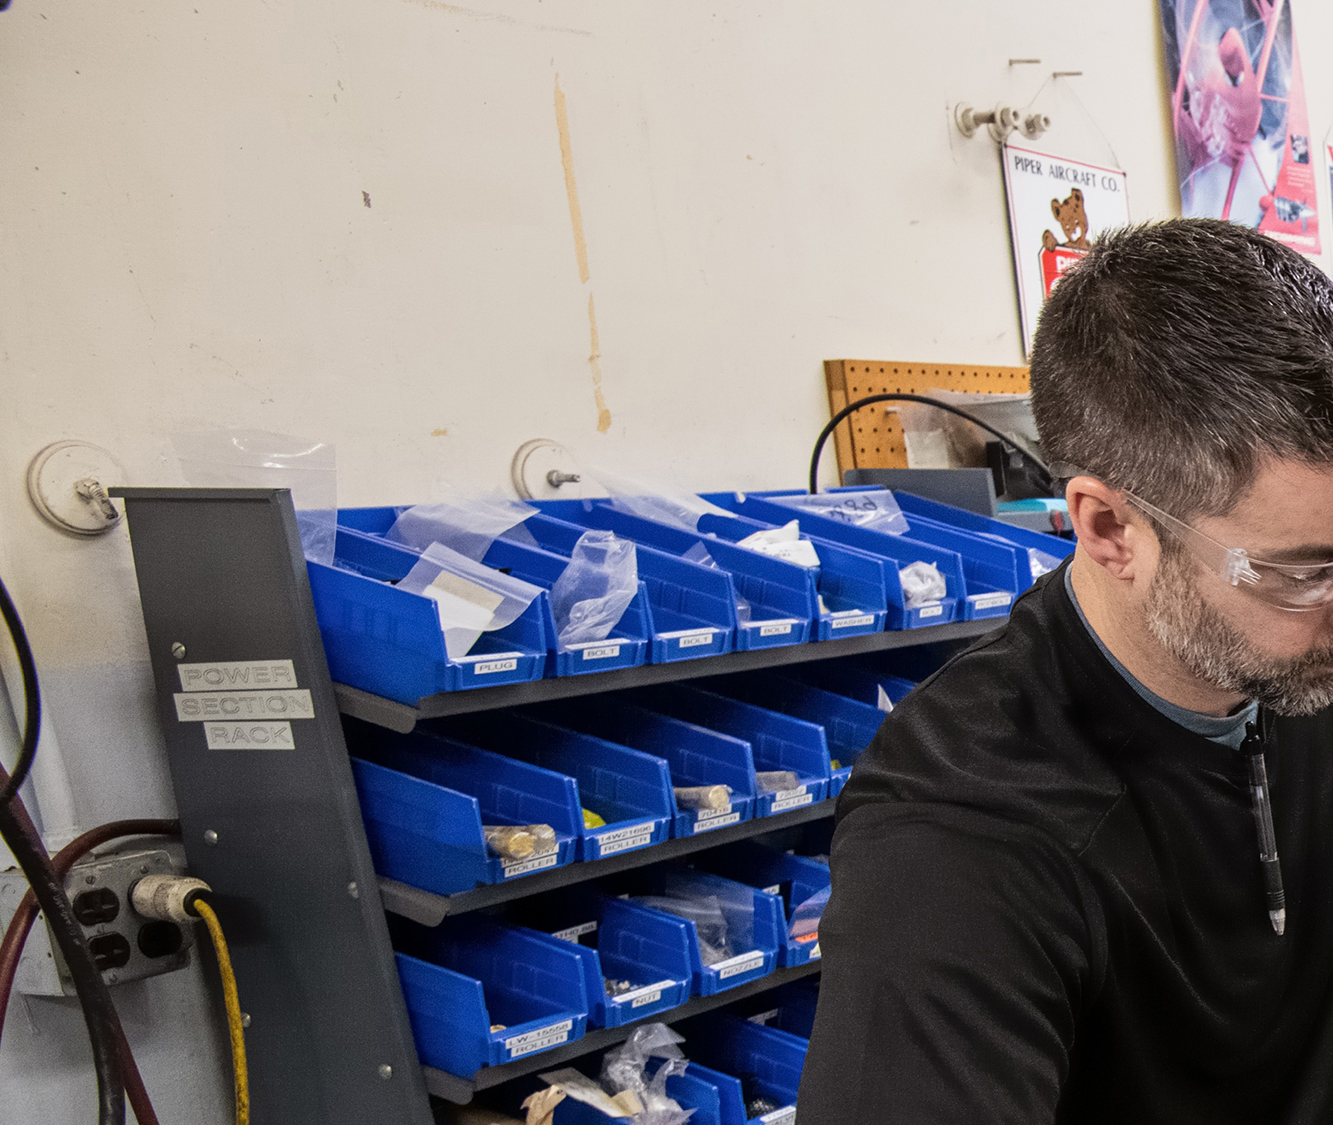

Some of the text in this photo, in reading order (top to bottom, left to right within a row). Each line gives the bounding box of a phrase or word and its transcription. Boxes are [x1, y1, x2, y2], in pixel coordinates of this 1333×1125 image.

[1014, 156, 1121, 192] PIPER AIRCRAFT CO.
[763, 625, 789, 635] BOLT
[834, 617, 873, 628] WASHER
[682, 635, 710, 646] BOLT
[586, 647, 617, 658] BOLT
[478, 660, 514, 673] PLUG
[184, 666, 292, 685] POWER
[181, 695, 310, 716] SECTION
[210, 726, 290, 744] RACK
[774, 796, 811, 810] ROLLER
[697, 814, 738, 831] ROLLER
[603, 835, 648, 854] ROLLER
[508, 857, 555, 876] ROLLER
[723, 960, 761, 977] NOZZLE
[635, 994, 658, 1006] NUT
[514, 1035, 565, 1055] ROLLER
